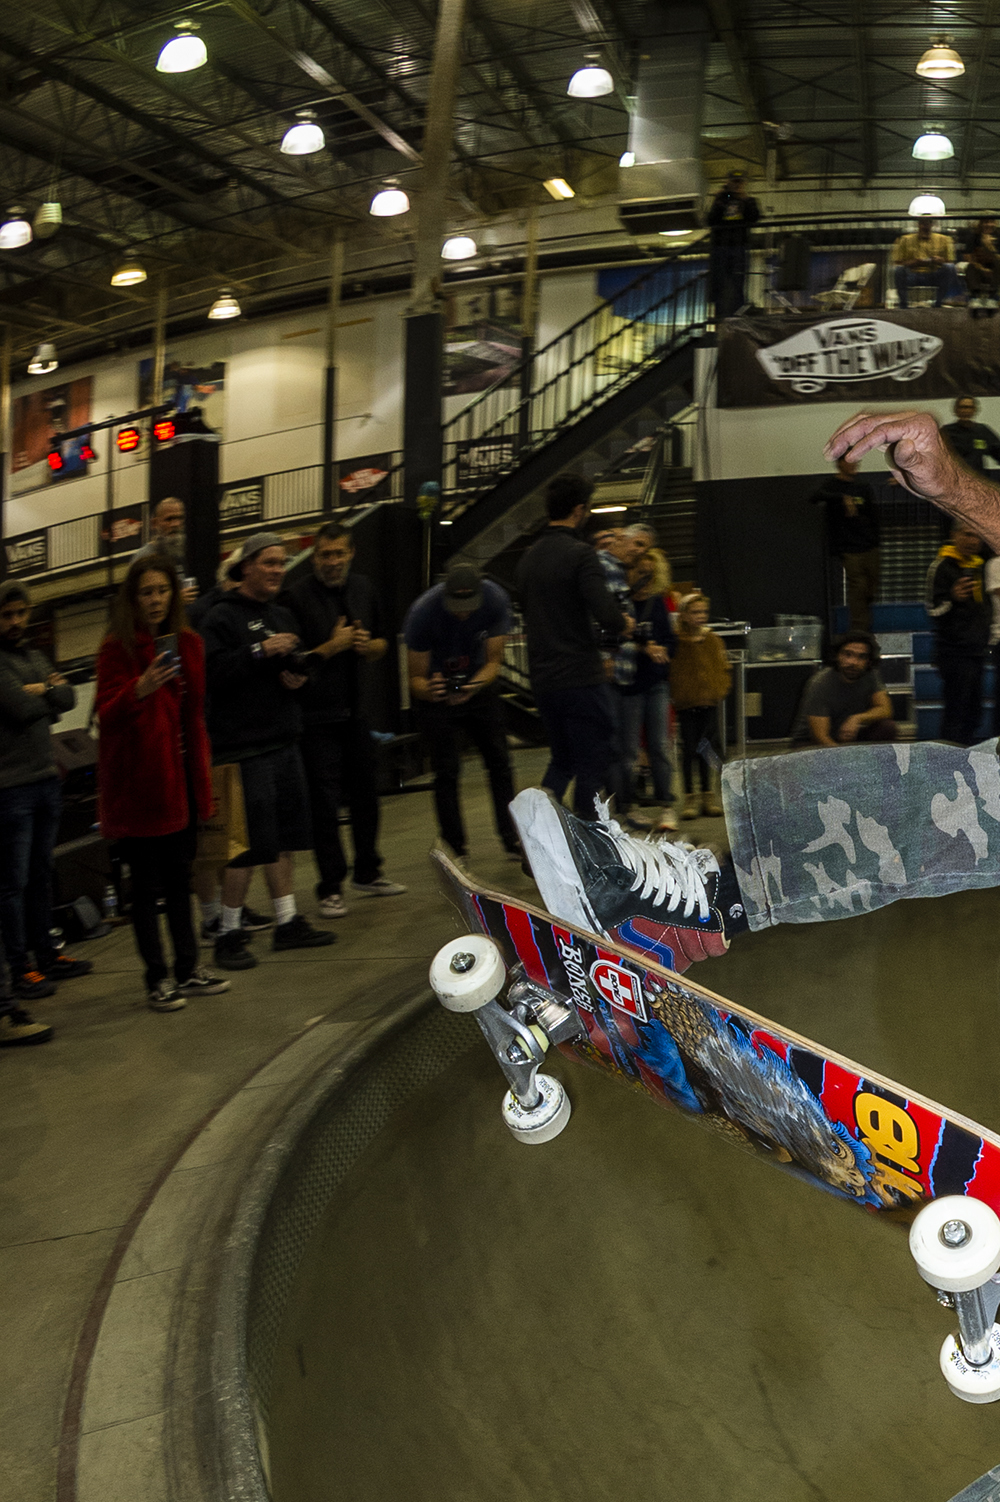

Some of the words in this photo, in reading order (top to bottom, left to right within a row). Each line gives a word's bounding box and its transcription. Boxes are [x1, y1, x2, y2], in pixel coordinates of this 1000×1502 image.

[811, 322, 878, 349] VANS
[821, 345, 866, 375] THE
[558, 936, 595, 1013] BONES
[609, 973, 623, 1003] BONES
